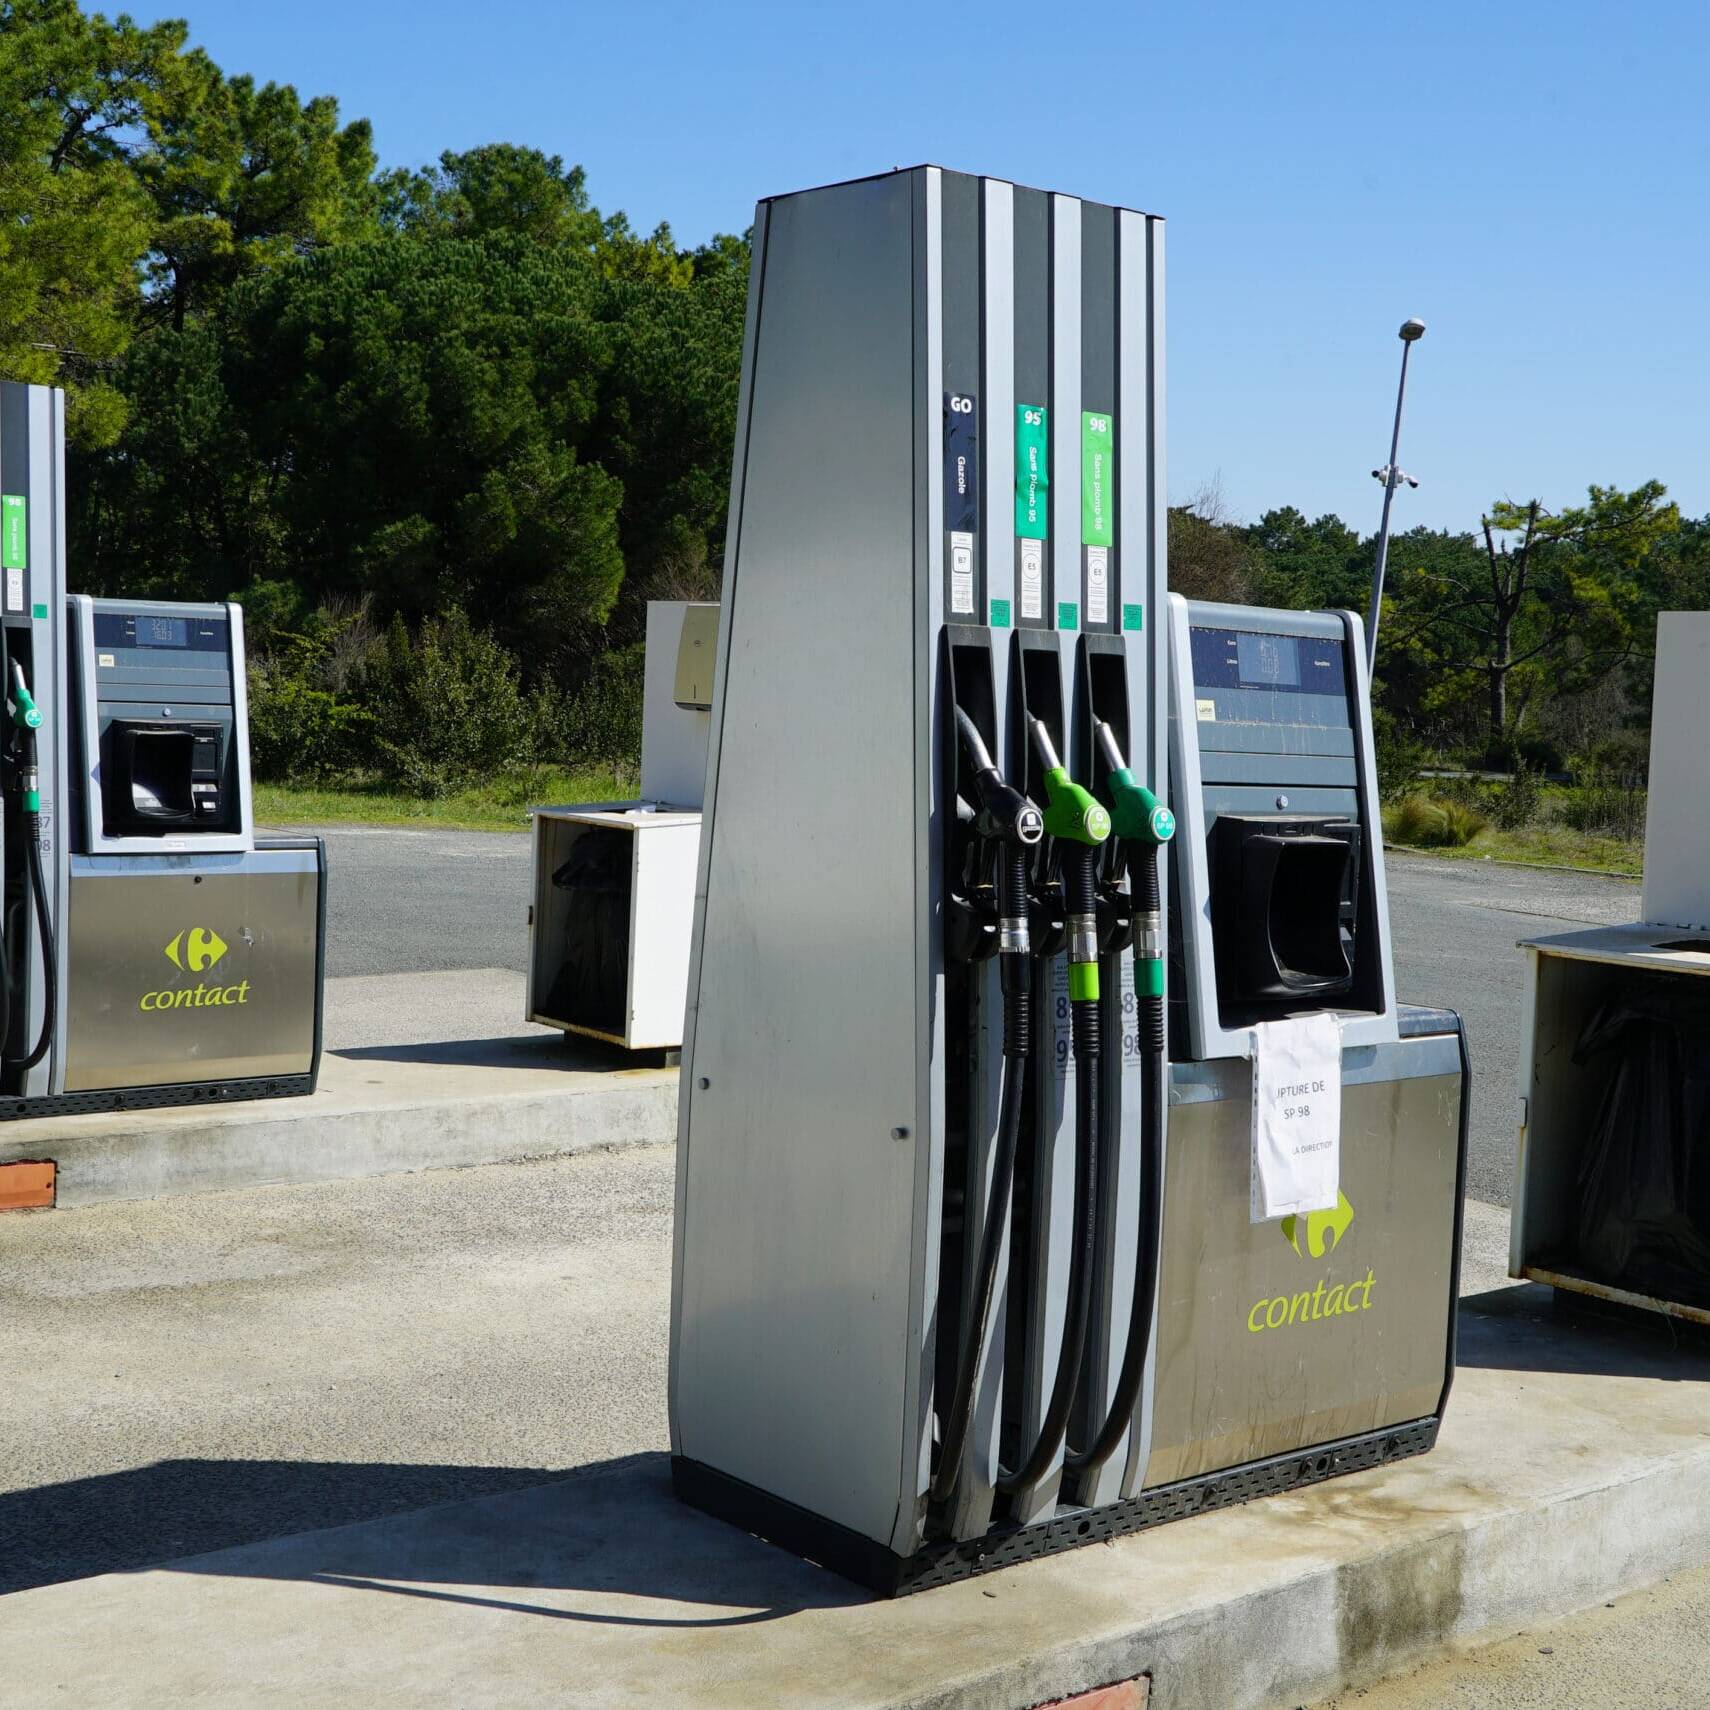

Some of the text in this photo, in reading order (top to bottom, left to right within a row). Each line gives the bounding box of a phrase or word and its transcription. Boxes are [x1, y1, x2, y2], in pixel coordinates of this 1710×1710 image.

[951, 397, 972, 413] GO
[1024, 410, 1042, 426] 95
[1089, 417, 1107, 432] 98
[957, 456, 967, 494] Gazole
[1094, 453, 1103, 480] Sans
[1028, 446, 1038, 522] Sans plomb 95
[1093, 481, 1102, 515] plomb
[1027, 562, 1037, 571] E5
[40, 839, 51, 851] 8
[140, 980, 251, 1010] contact
[1277, 1081, 1325, 1098] PTURE DE
[1284, 1105, 1310, 1120] SP 98
[1247, 1269, 1377, 1333] contact
